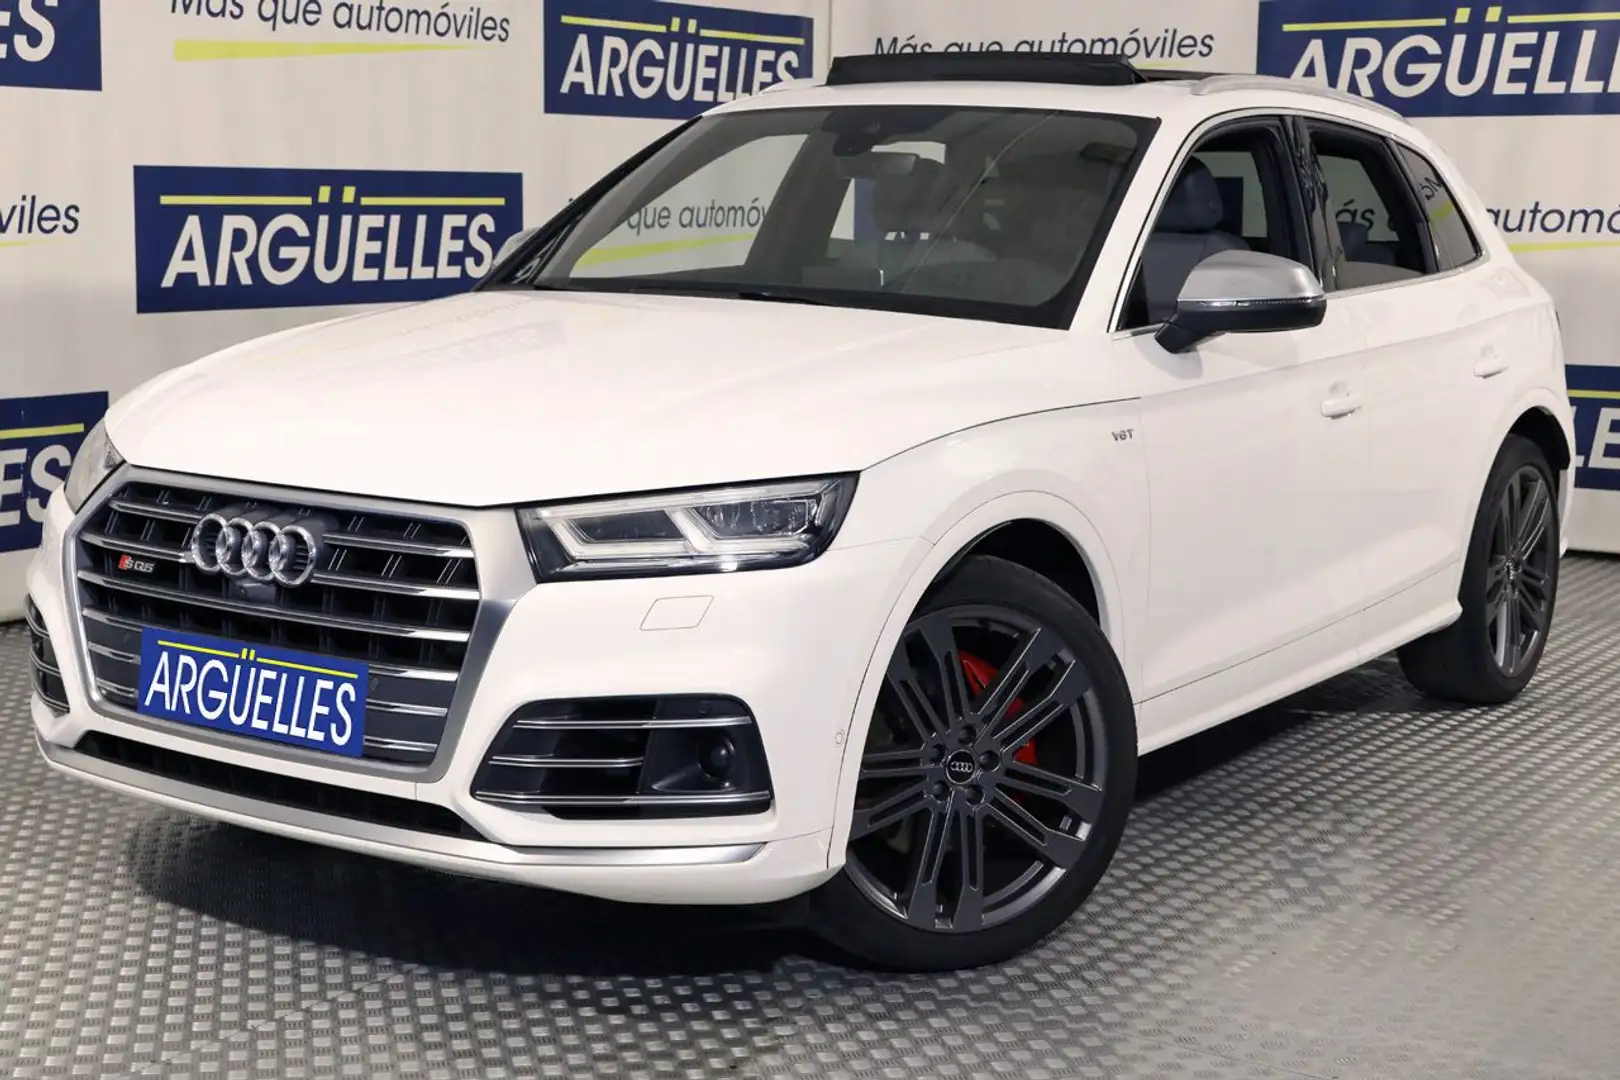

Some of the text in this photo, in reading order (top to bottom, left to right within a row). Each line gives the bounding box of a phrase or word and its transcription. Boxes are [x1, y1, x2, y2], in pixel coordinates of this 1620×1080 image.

[257, 0, 322, 31] que
[333, 2, 510, 42] automóviles
[560, 16, 799, 103] ARGÜELLES
[1289, 6, 1620, 98] ARGÜELL
[160, 186, 496, 288] ARGÜELLES
[1111, 428, 1134, 441] V6T
[144, 648, 356, 746] ARGÜELLES
